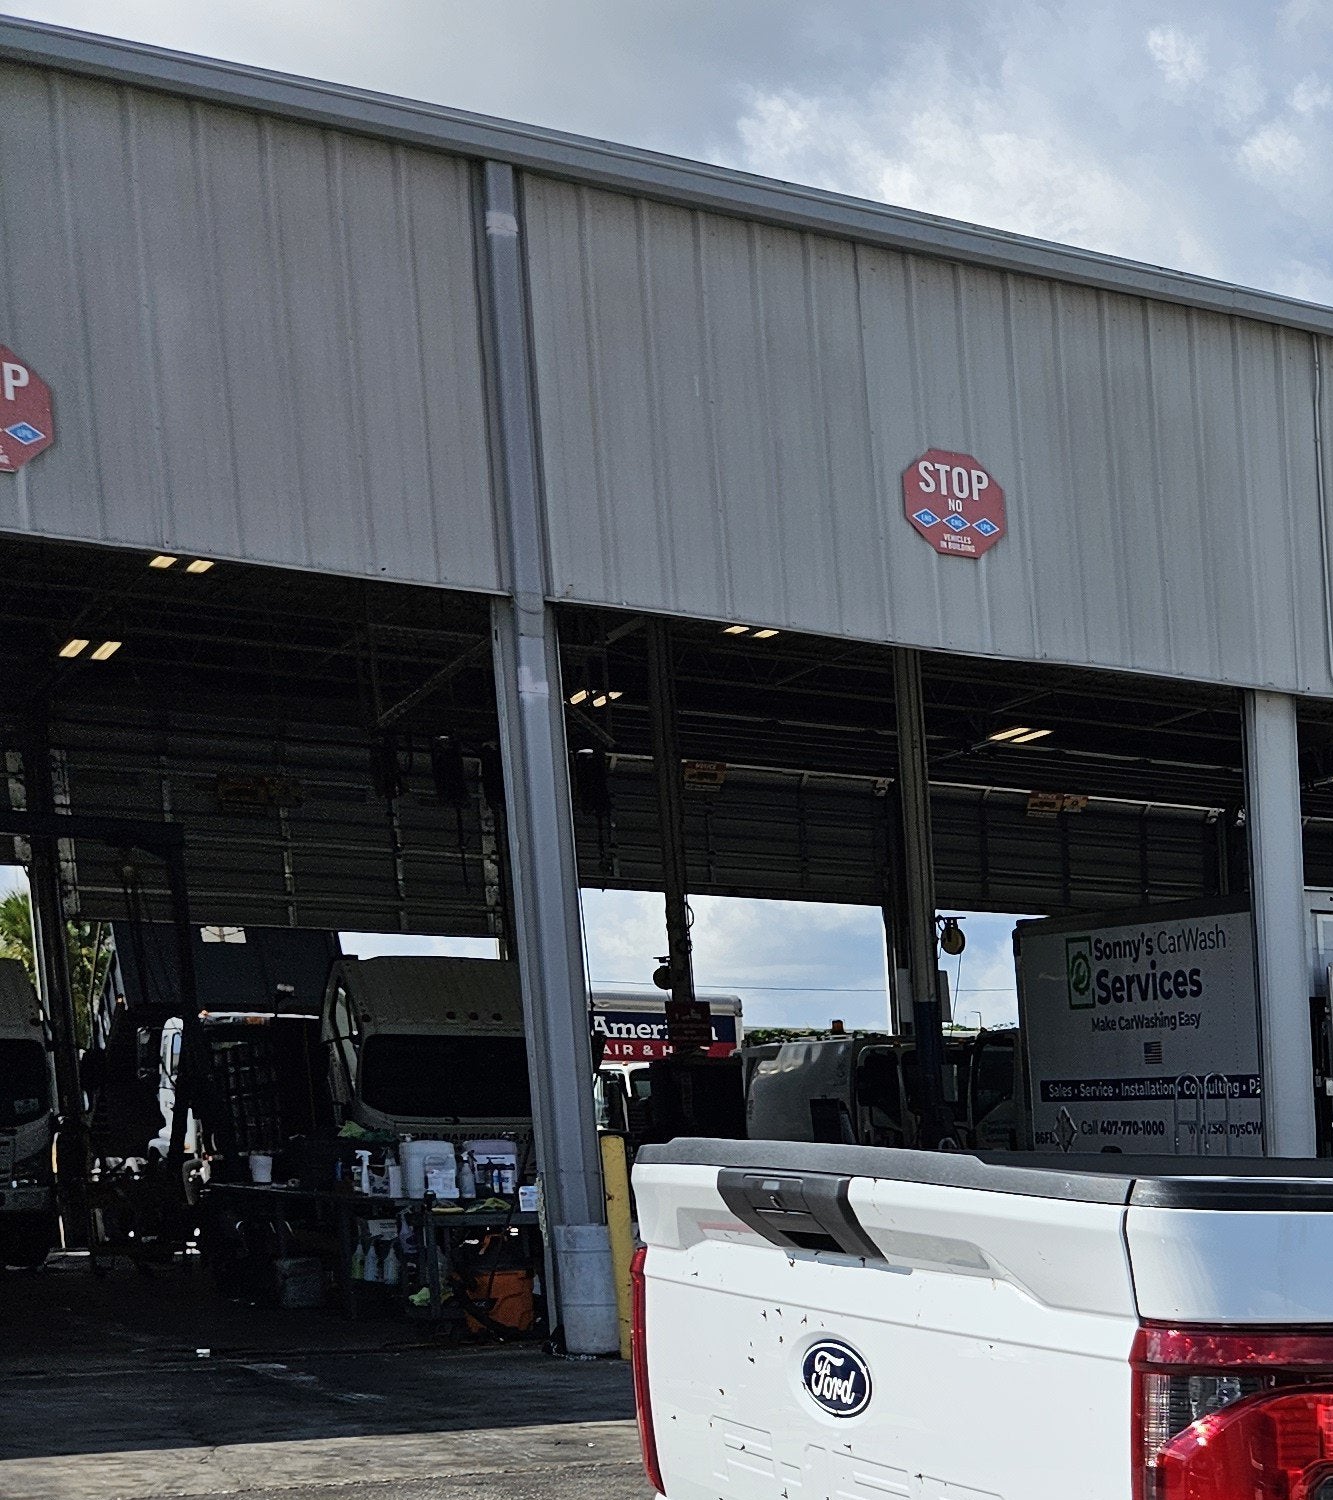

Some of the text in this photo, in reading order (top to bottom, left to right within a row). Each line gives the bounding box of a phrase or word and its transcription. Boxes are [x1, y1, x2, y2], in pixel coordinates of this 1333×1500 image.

[918, 460, 989, 501] STOP
[948, 498, 963, 512] NO
[943, 533, 972, 545] VEHICLES
[1093, 923, 1226, 964] Sonny's CarWash
[1095, 960, 1203, 1005] Services
[1091, 1011, 1201, 1033] Make CarWashing Easy
[602, 1044, 634, 1056] AIR
[642, 1044, 654, 1056] &
[1048, 1084, 1072, 1098] Sales
[1079, 1082, 1114, 1097] Service
[1121, 1081, 1175, 1096] Installation
[1183, 1079, 1240, 1097] Conulting
[1081, 1121, 1098, 1135] Call
[811, 1350, 856, 1405] Ford
